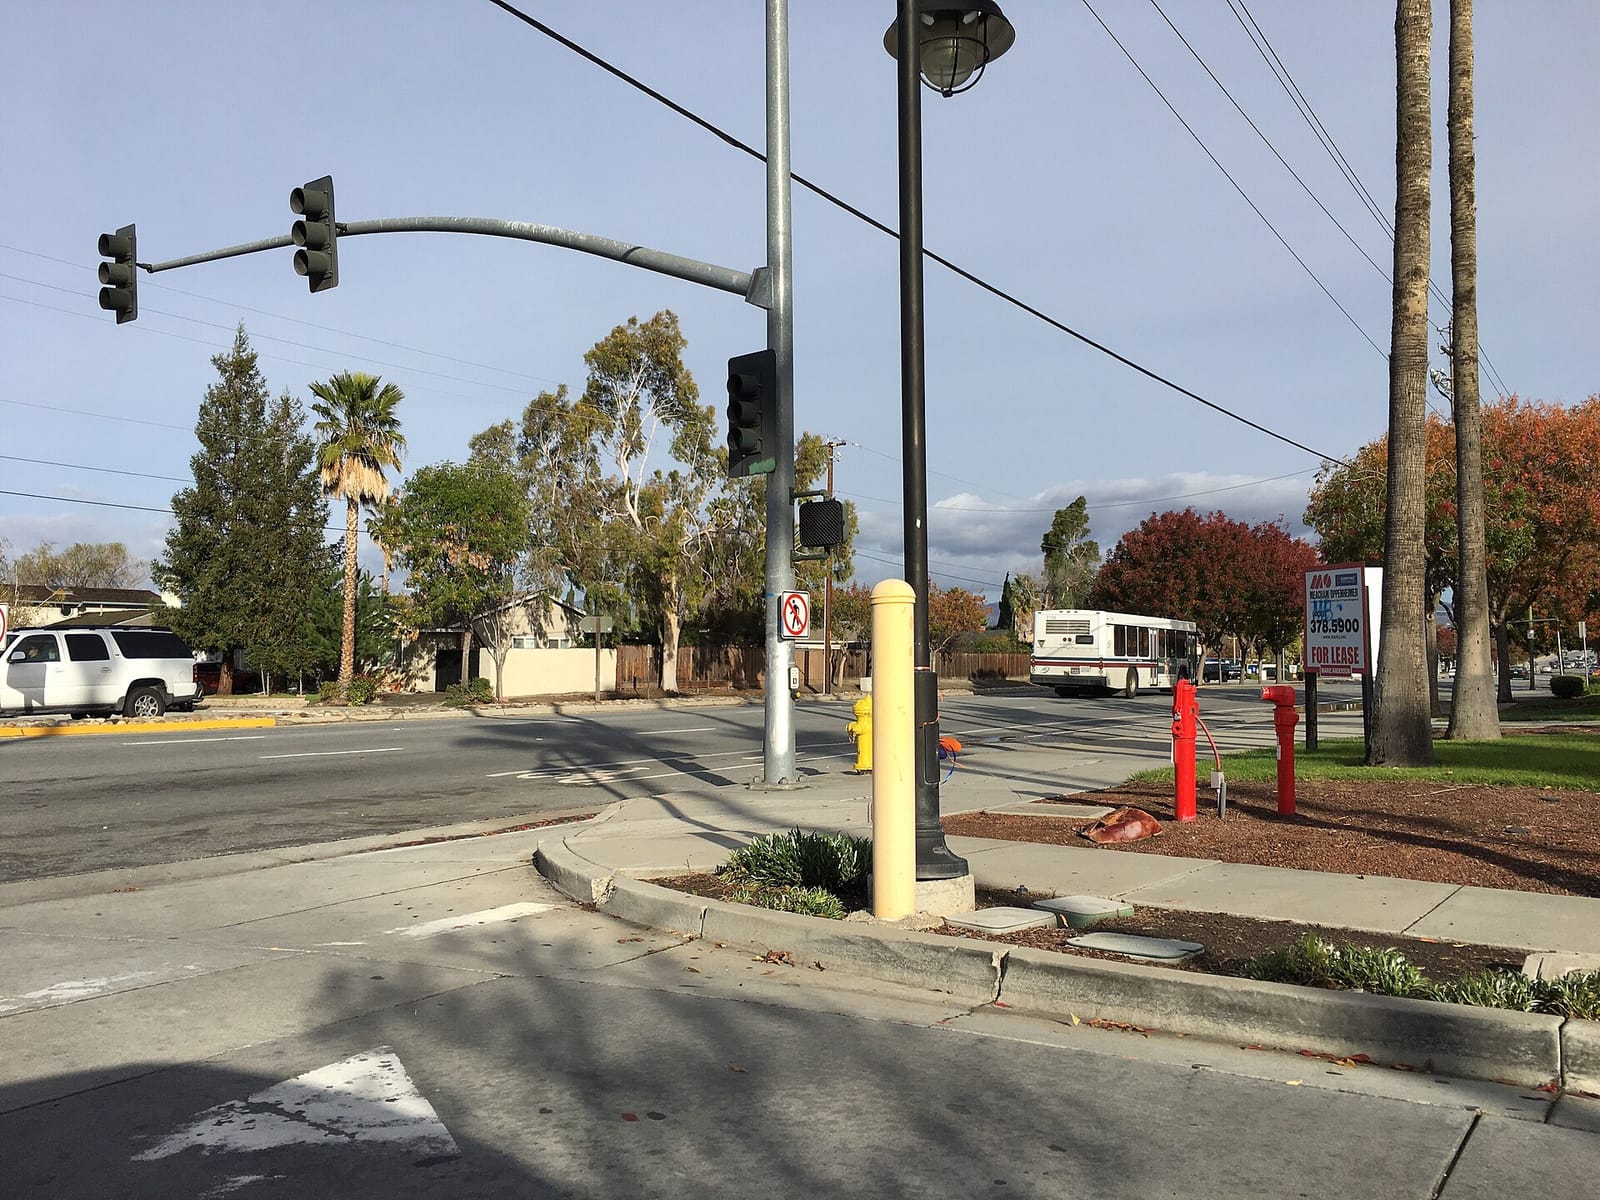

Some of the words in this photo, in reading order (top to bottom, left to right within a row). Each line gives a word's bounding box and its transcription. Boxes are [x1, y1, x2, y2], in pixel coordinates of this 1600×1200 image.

[1310, 618, 1360, 634] 378.5900
[1311, 646, 1329, 664] FOR
[1331, 646, 1360, 665] LEASE
